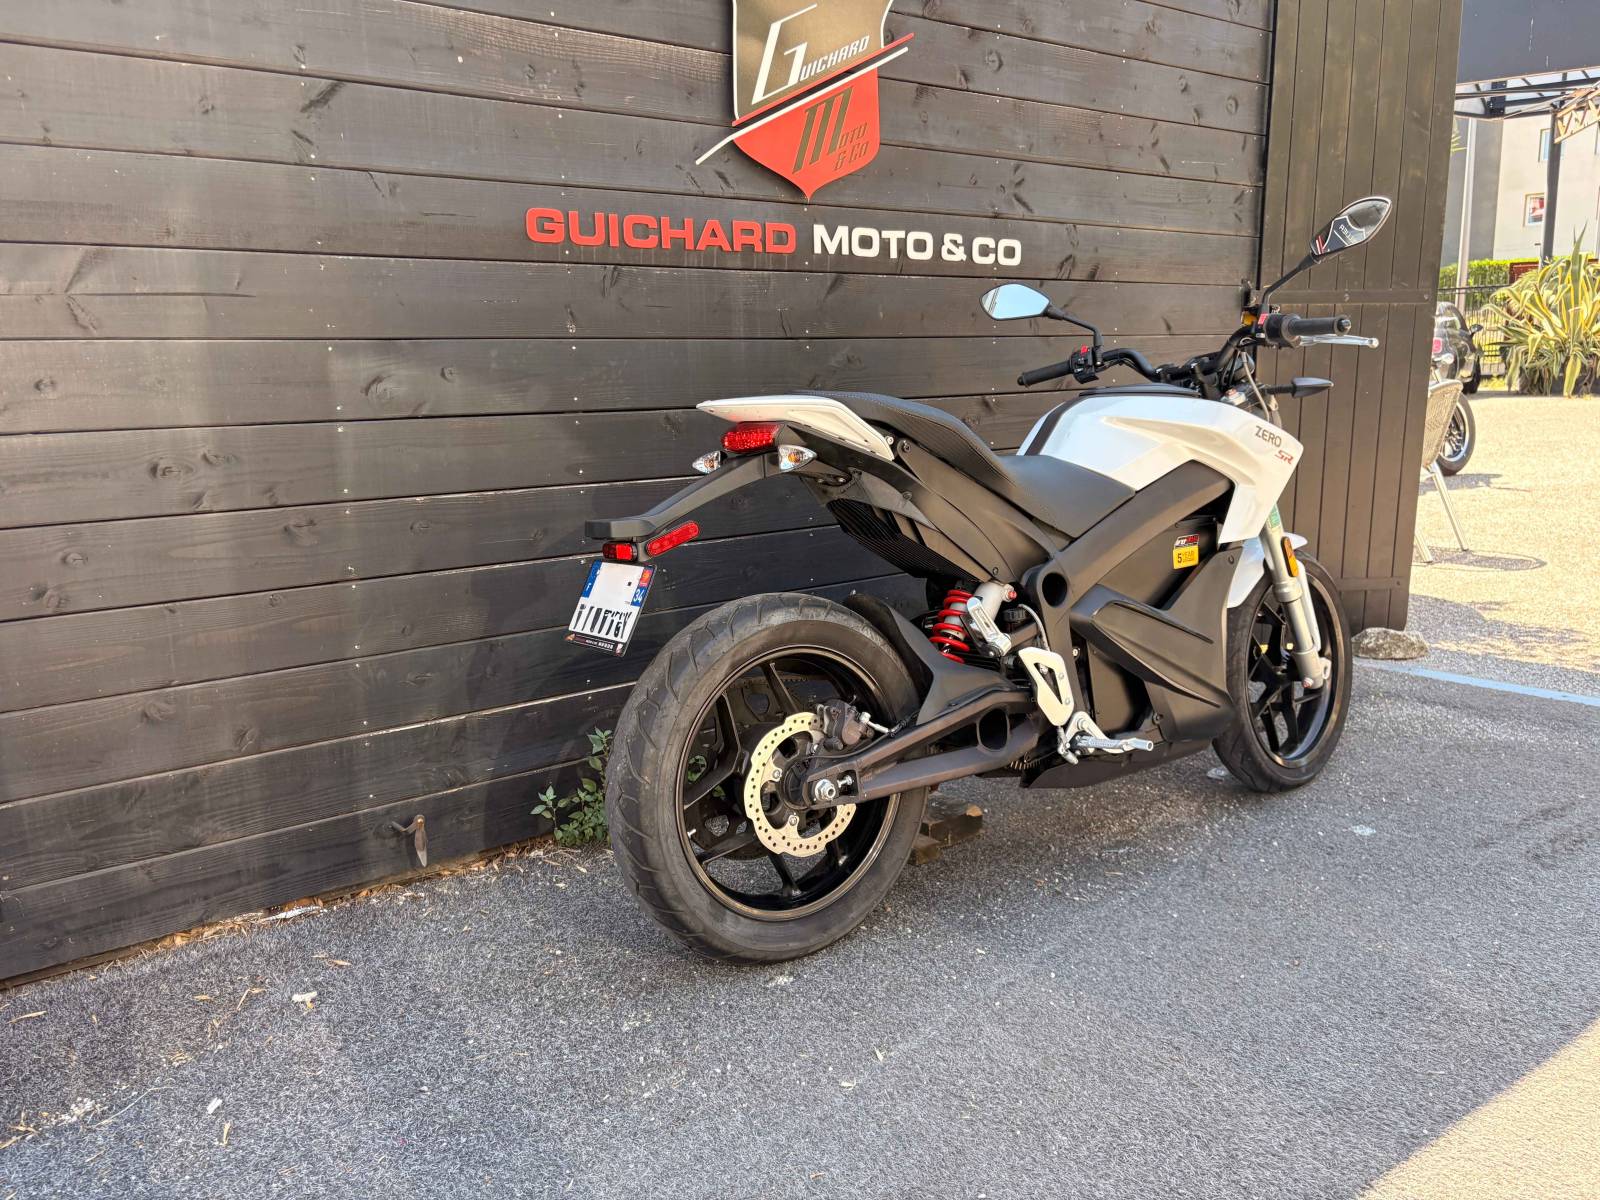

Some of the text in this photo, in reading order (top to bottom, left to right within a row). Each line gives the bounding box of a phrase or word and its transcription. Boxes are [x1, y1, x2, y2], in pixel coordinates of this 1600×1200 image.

[525, 207, 798, 255] GUICHARD
[1254, 425, 1283, 448] ZERO
[633, 588, 646, 603] 34
